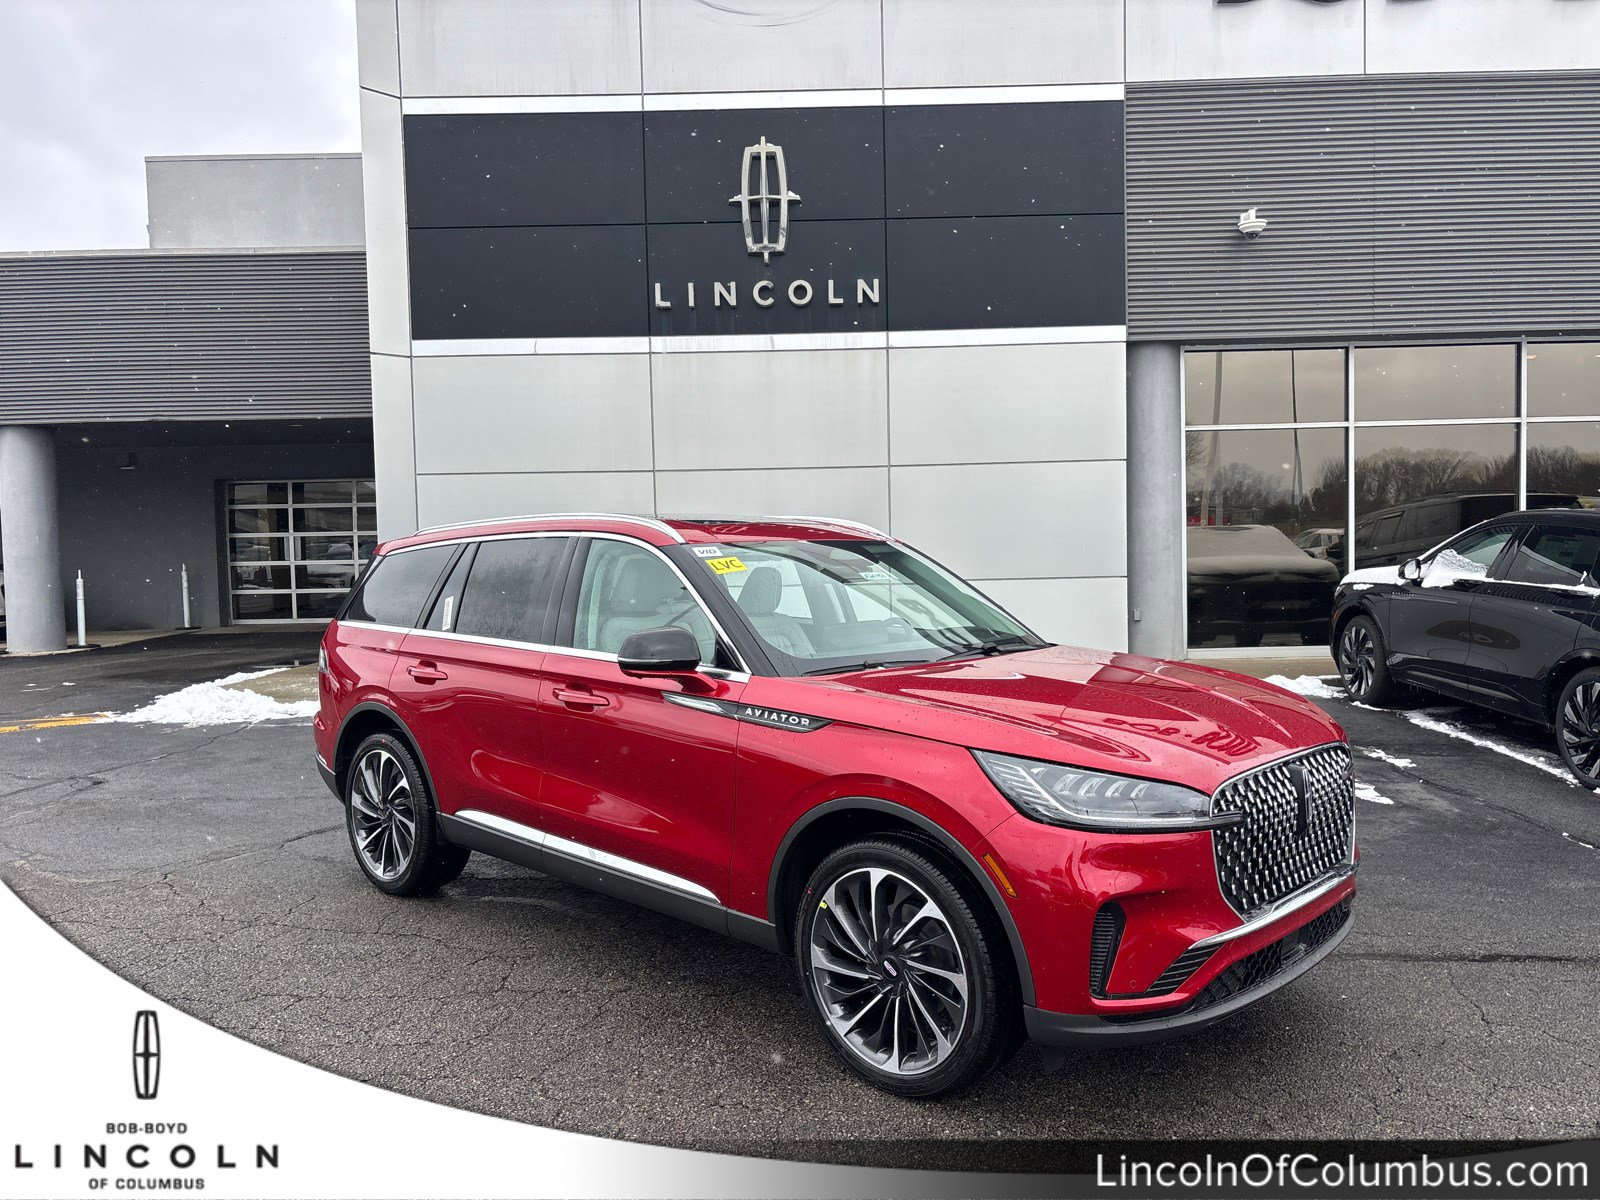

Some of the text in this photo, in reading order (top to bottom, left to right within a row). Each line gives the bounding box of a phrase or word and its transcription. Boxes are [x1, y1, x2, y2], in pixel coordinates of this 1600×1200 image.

[654, 278, 880, 308] LINCOLN
[710, 559, 743, 571] LVC
[745, 707, 810, 727] AVIATOR
